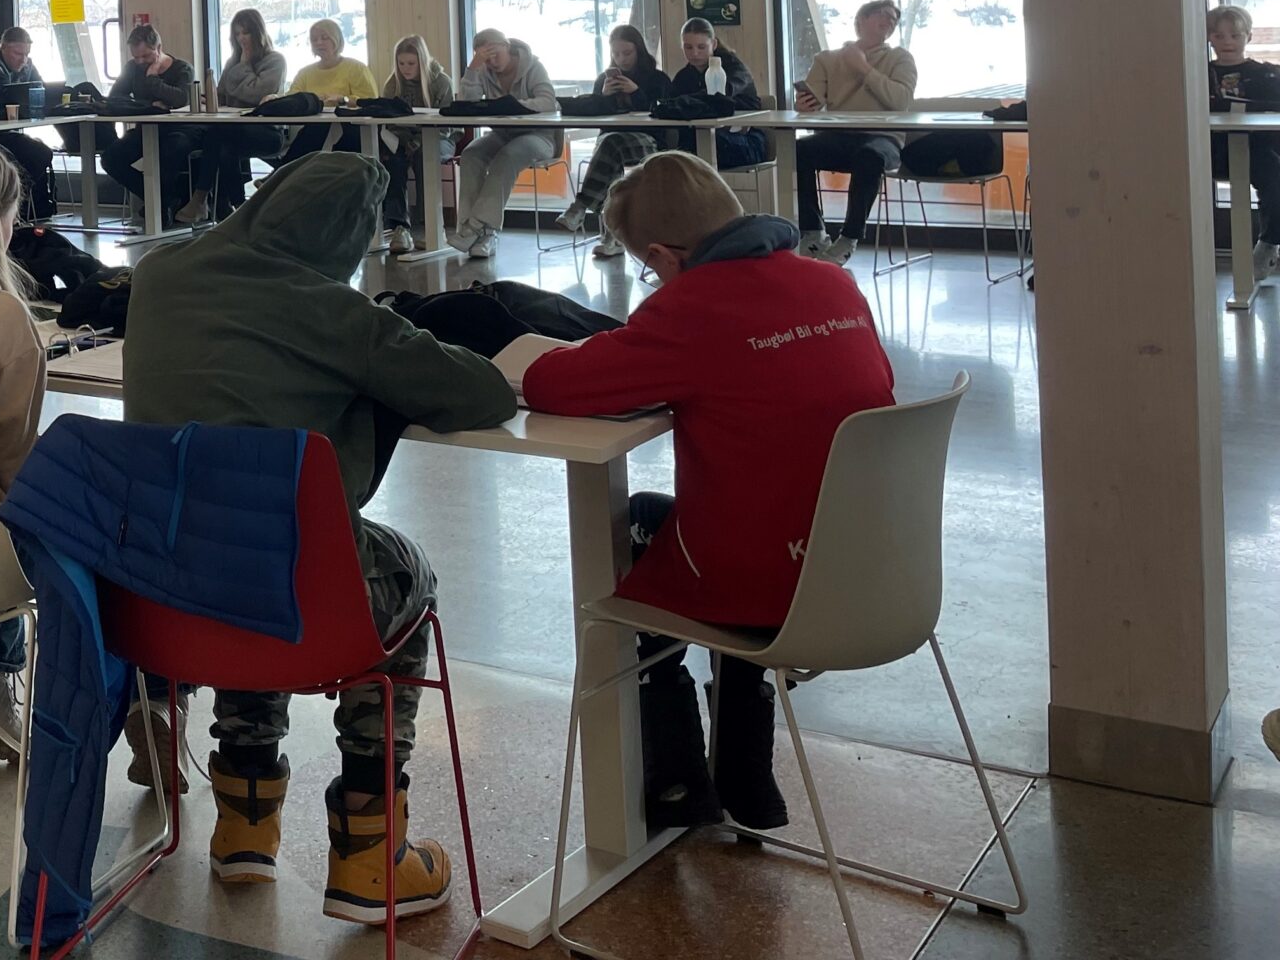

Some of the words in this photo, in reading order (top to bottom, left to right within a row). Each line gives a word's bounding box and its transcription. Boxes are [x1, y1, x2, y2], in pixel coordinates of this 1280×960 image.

[747, 328, 795, 350] Taugbøl
[796, 325, 812, 339] Bil
[813, 325, 830, 336] og
[827, 317, 857, 330] Maskin
